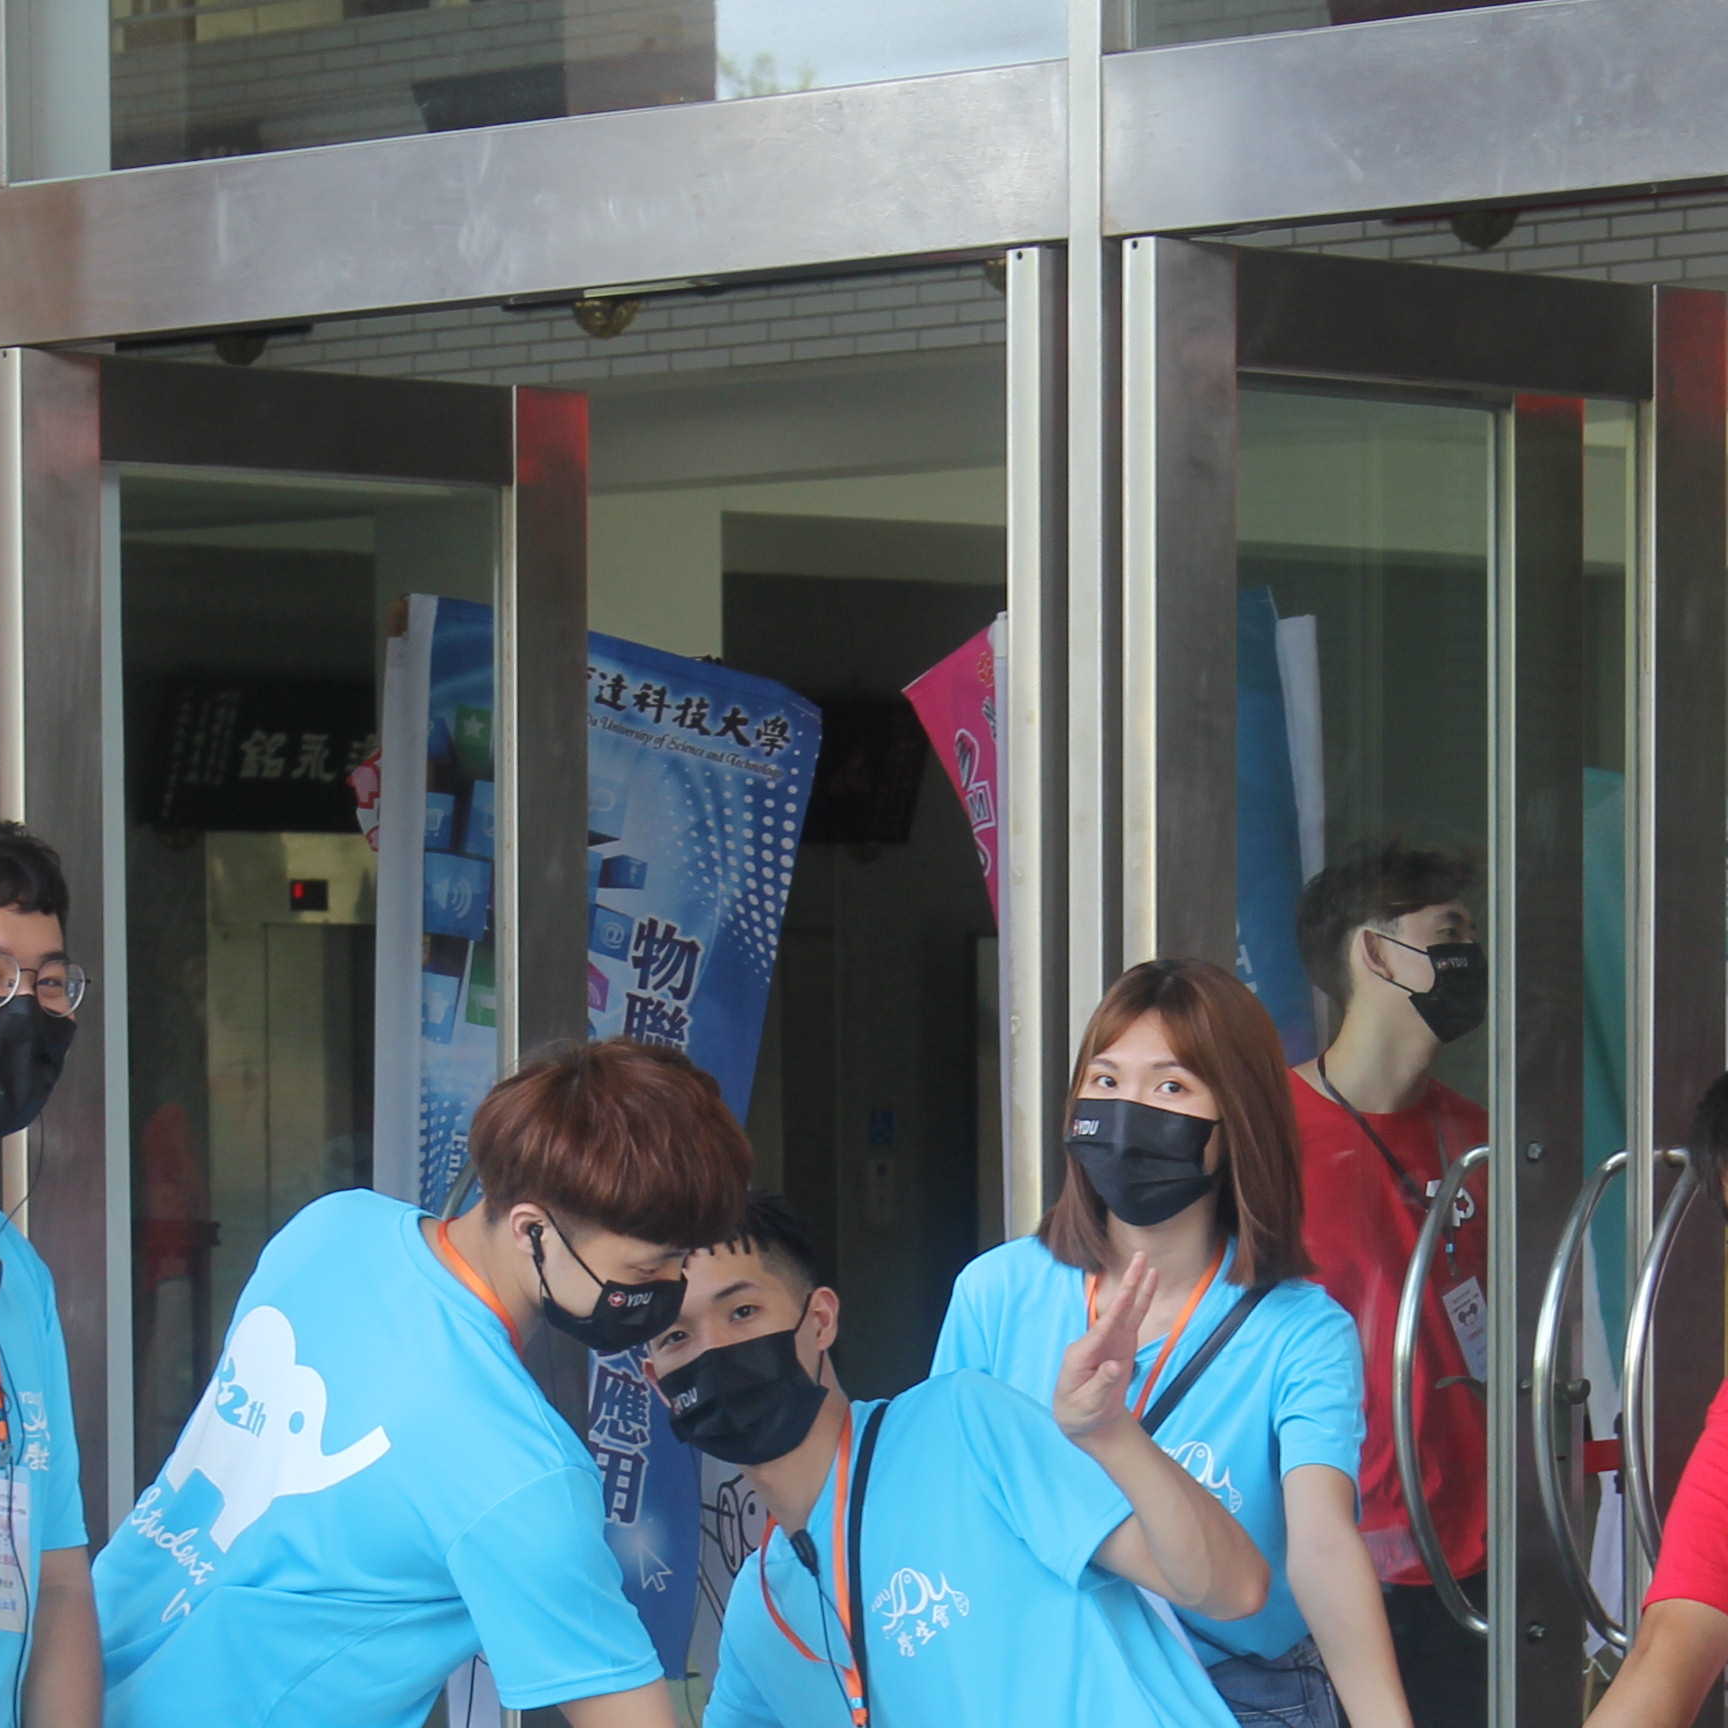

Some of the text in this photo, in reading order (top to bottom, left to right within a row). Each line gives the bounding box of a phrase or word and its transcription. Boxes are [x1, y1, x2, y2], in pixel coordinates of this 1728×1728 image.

[587, 665, 792, 758] 達科技大學
[599, 714, 654, 745] University
[666, 735, 706, 760] Science
[705, 749, 725, 763] and
[725, 752, 786, 780] Technology
[626, 1291, 654, 1308] YDU
[677, 1387, 699, 1412] YDU
[130, 1487, 215, 1586] Student
